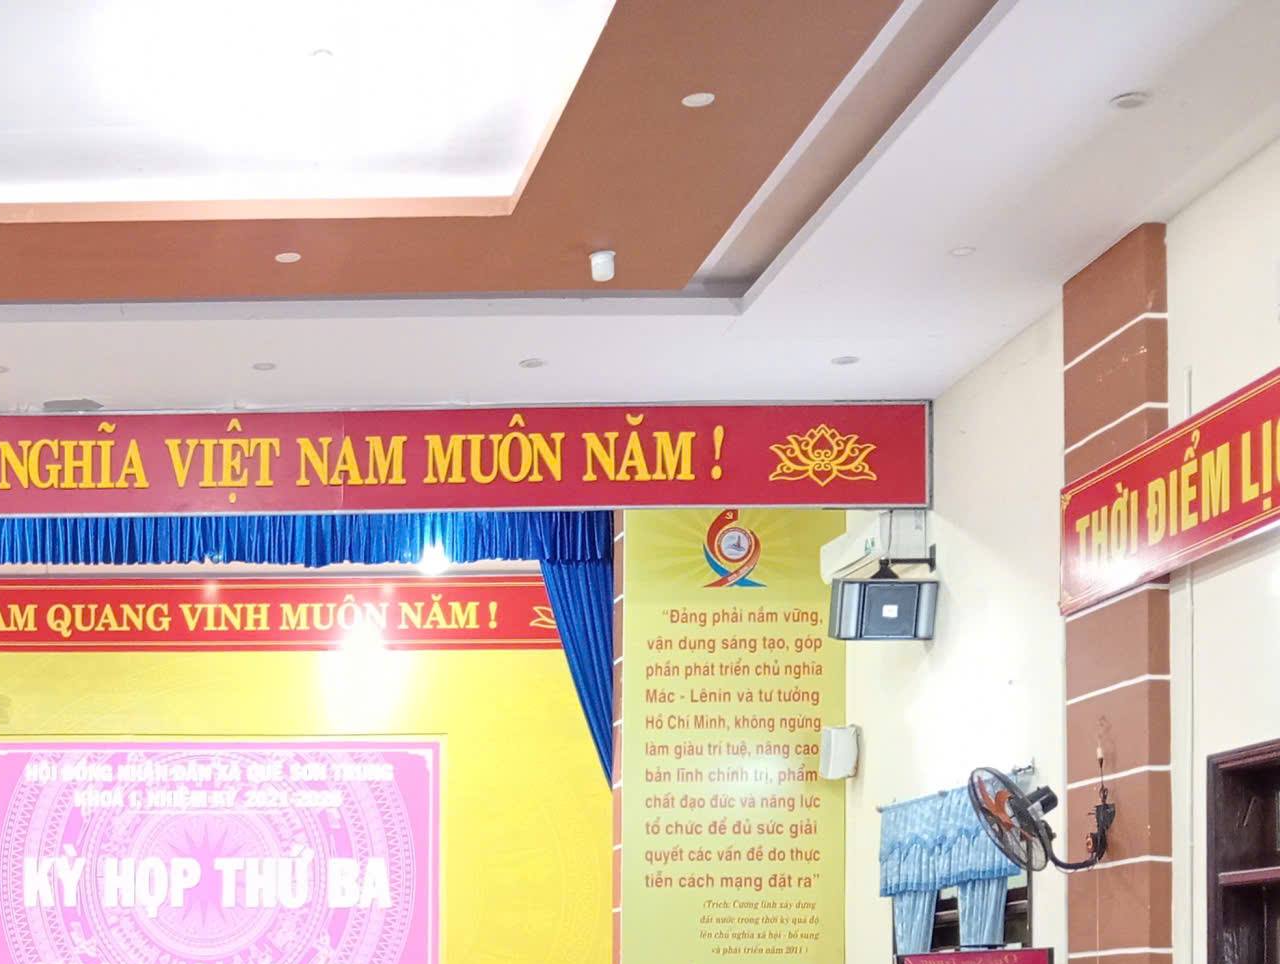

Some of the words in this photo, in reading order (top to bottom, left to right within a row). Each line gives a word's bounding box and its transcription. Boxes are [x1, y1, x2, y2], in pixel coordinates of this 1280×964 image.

[165, 418, 280, 504] VIỆT
[296, 436, 407, 486] NAM
[423, 414, 565, 484] MUÔN
[583, 413, 696, 482] NĂM
[1075, 481, 1139, 564] THỜI
[1147, 429, 1231, 547] ĐIỂM
[1241, 417, 1280, 511] LỊ
[46, 602, 172, 638] QUANG
[179, 602, 271, 632] VINH
[279, 594, 388, 631] MUÔN
[398, 594, 480, 630] NĂM
[711, 606, 743, 627] phải
[747, 606, 779, 623] nắm
[647, 635, 673, 652] vận
[678, 636, 716, 654] dụng
[721, 638, 757, 654] sáng
[794, 637, 823, 654] góp
[645, 660, 680, 680] phần
[684, 662, 715, 680] phát
[719, 657, 750, 677] triển
[754, 659, 781, 677] chủ
[784, 660, 824, 680] nghĩa
[645, 688, 675, 704] Mác
[690, 688, 732, 703] Lênin
[736, 691, 754, 703] và
[758, 689, 772, 703] tư
[777, 686, 820, 707] tưởng
[645, 714, 664, 730] Hồ
[667, 714, 690, 730] Chí
[734, 715, 775, 733] không
[645, 741, 669, 757] làm
[673, 741, 704, 760] giàu
[707, 743, 723, 756] trí
[755, 743, 790, 760] nâng
[794, 743, 820, 756] cao
[645, 766, 671, 783] bản
[676, 767, 704, 783] lĩnh
[644, 792, 676, 809] chất
[679, 794, 706, 810] đạo
[709, 793, 736, 809] đức
[739, 796, 756, 809] và
[760, 794, 796, 813] năng
[799, 794, 821, 810] lực
[645, 816, 661, 836] tổ
[665, 821, 704, 836] chức
[707, 817, 728, 836] để
[732, 818, 752, 835] đủ
[756, 820, 785, 835] sức
[789, 818, 818, 839] giải
[644, 847, 684, 865] quyết
[687, 849, 712, 862] các
[716, 845, 742, 862] vấn
[746, 845, 764, 862] đề
[767, 847, 786, 862] do
[789, 847, 821, 863] thực
[24, 845, 86, 908] KỲ
[104, 857, 201, 918] HỌP
[215, 844, 315, 908] THỨ
[327, 857, 391, 908] BA
[644, 870, 673, 888] tiễn
[678, 873, 714, 888] cách
[719, 876, 763, 893] mạng
[767, 873, 793, 889] đặt
